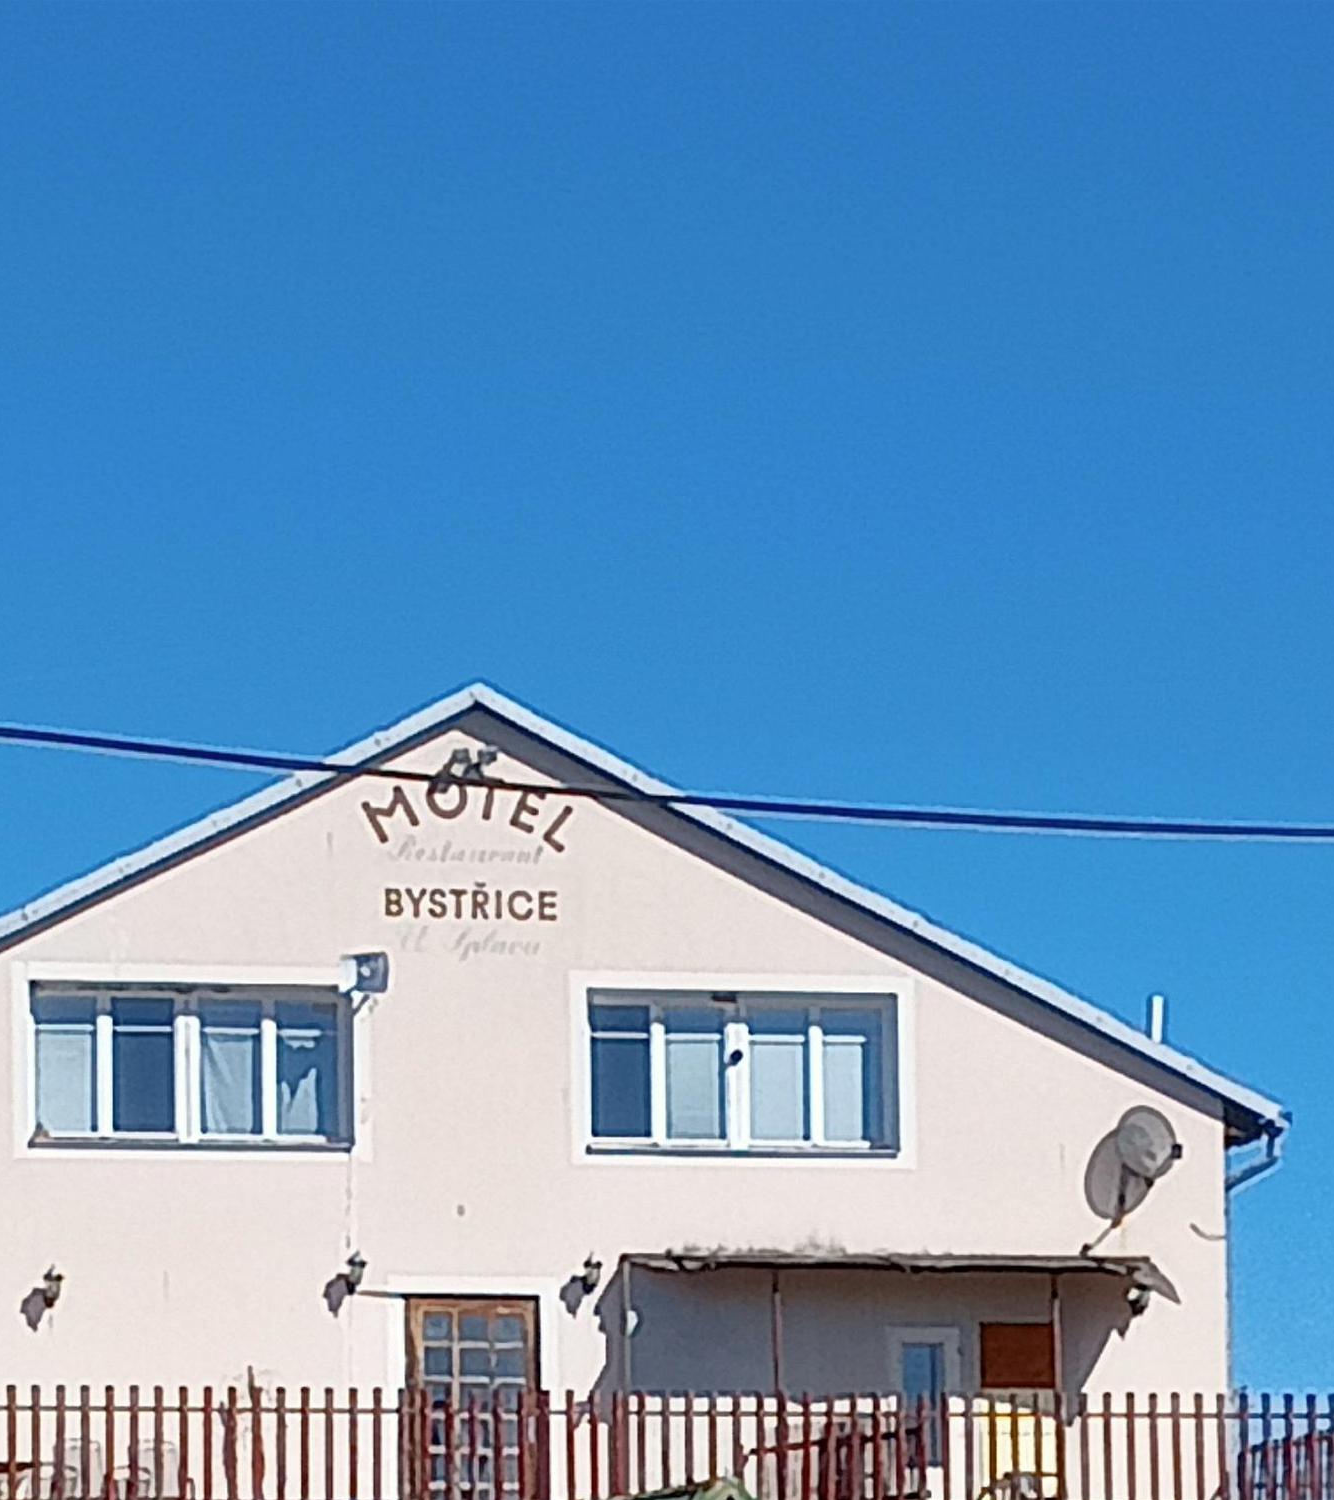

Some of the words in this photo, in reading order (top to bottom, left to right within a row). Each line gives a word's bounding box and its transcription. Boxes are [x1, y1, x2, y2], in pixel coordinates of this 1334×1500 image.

[361, 779, 573, 853] MOTEL
[387, 835, 544, 864] Restaurant
[384, 881, 558, 921] BYSTŘICE
